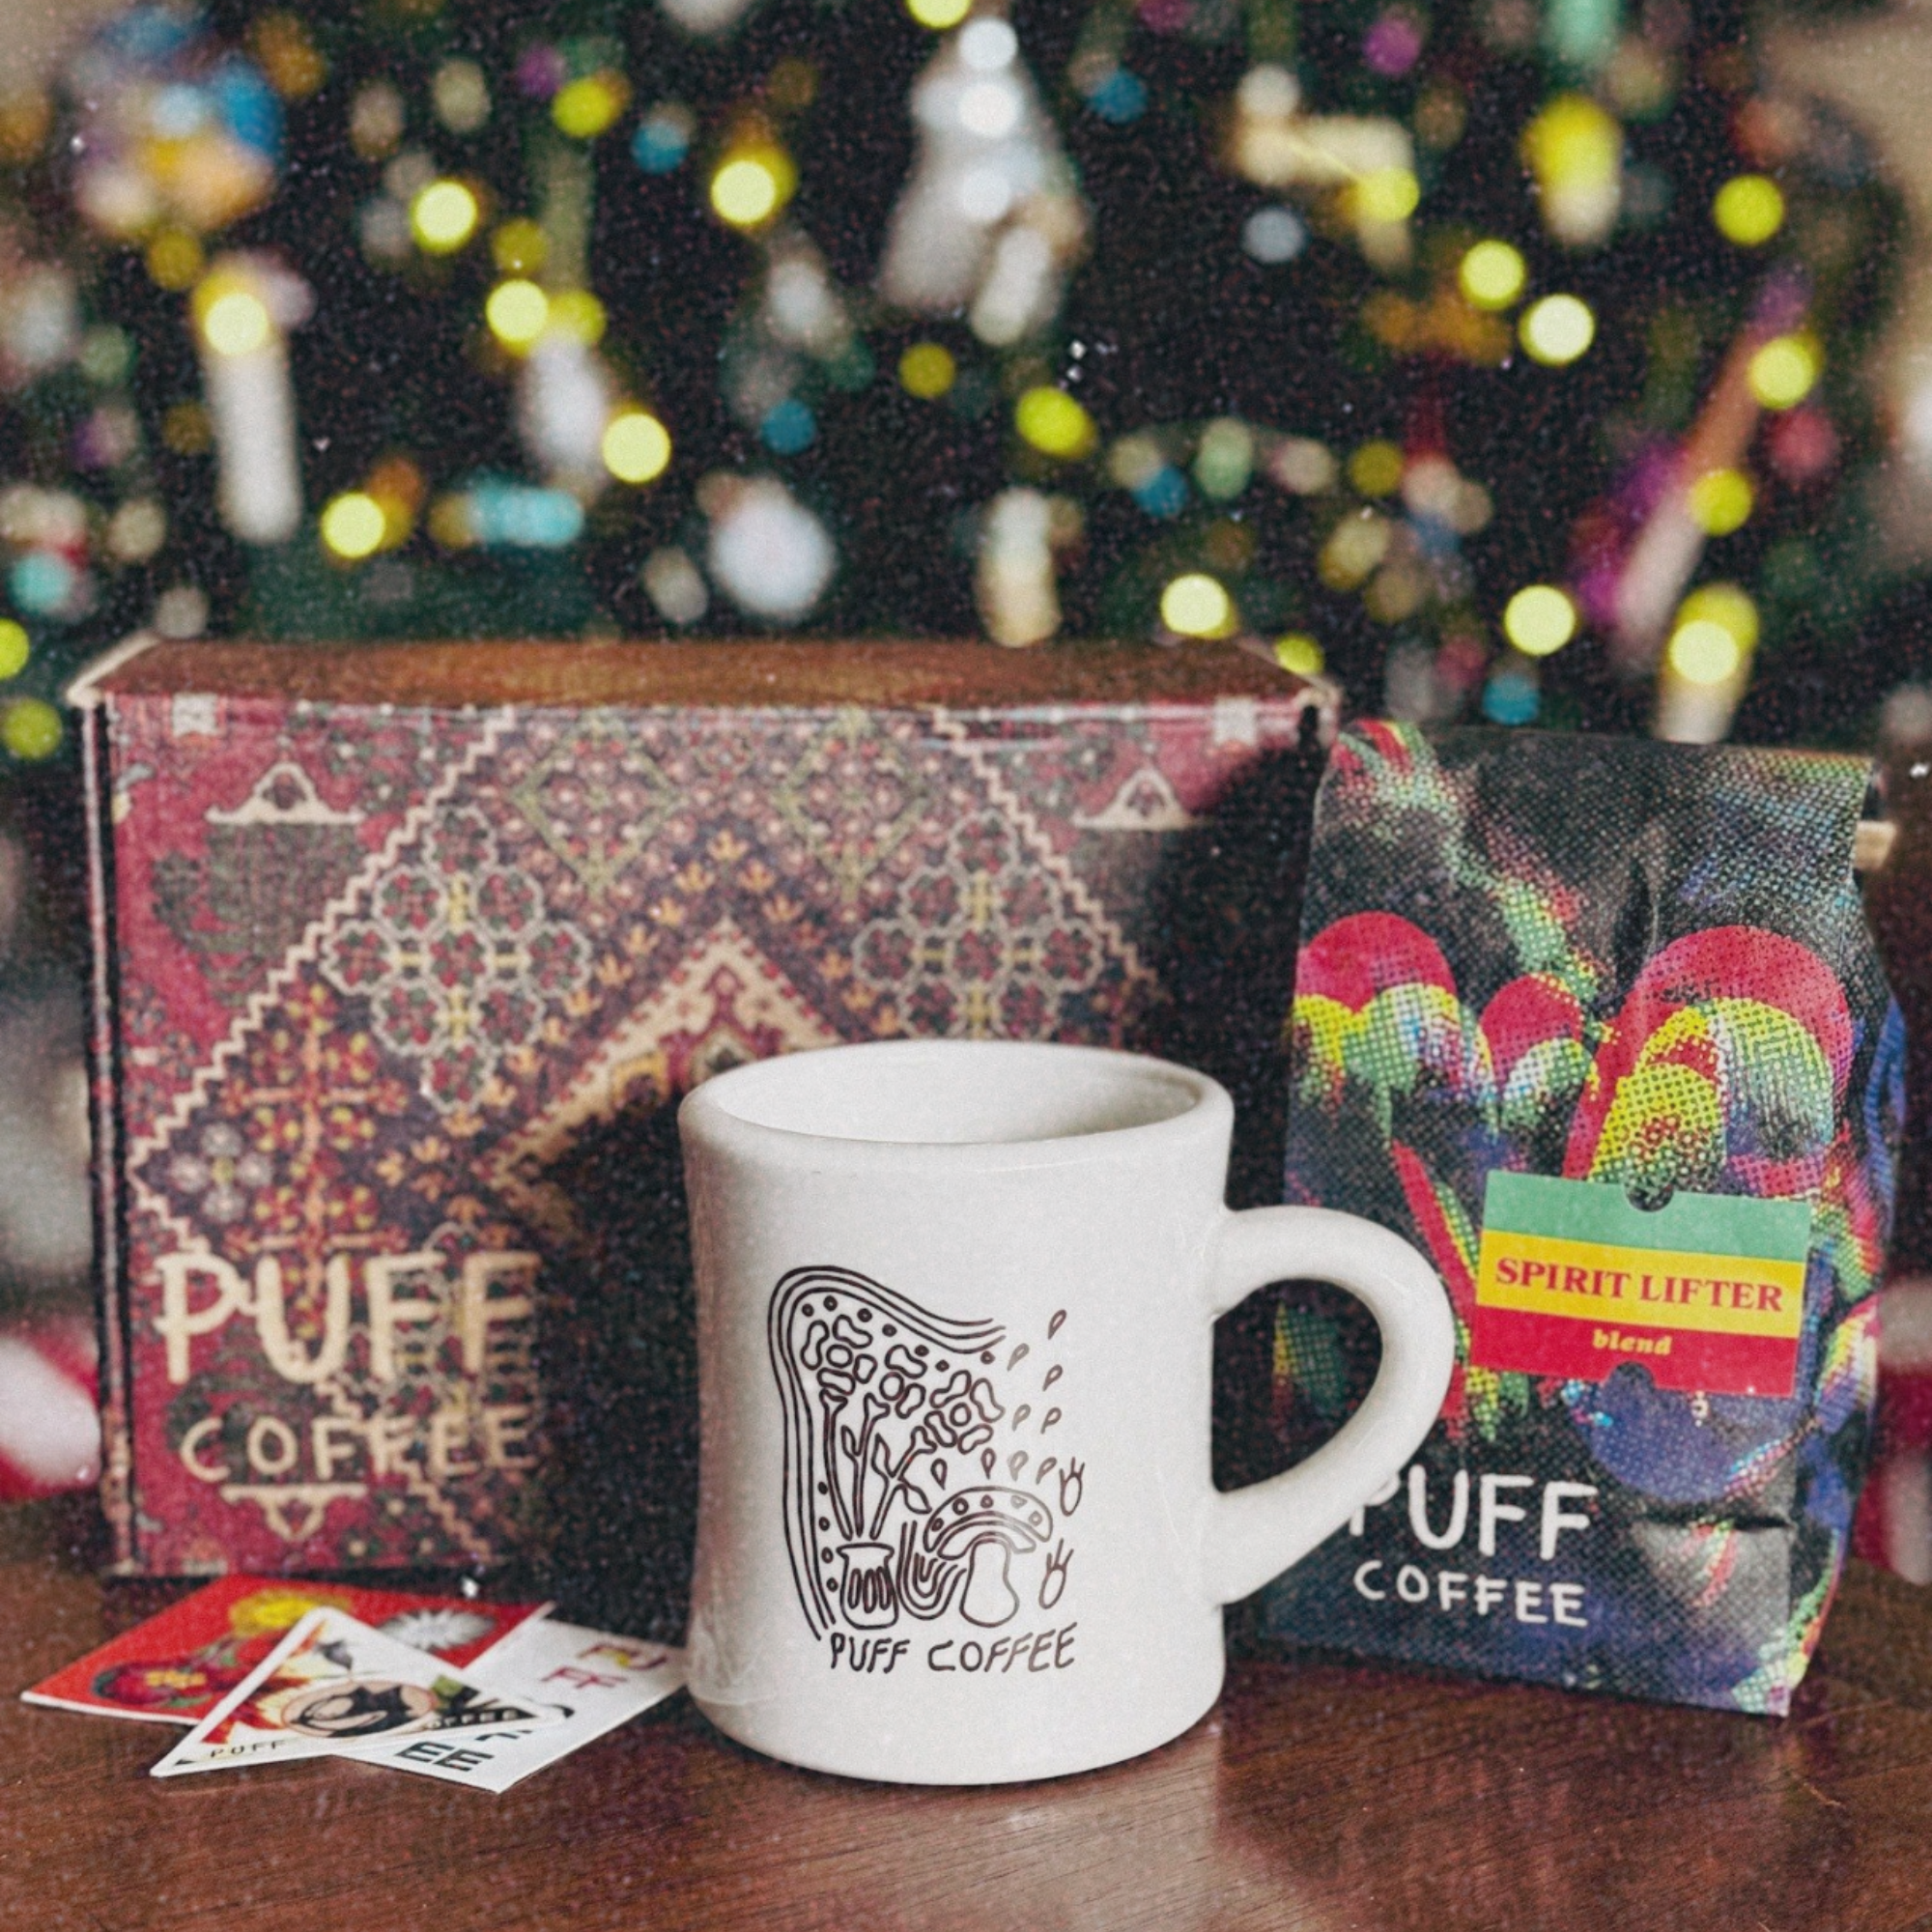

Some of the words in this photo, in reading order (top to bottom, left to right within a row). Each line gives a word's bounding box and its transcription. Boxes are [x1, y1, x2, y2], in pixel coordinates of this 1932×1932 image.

[1495, 1257, 1632, 1299] SPIRIT
[1639, 1274, 1784, 1313] LIFTER
[153, 1251, 543, 1383] PUFF
[1591, 1328, 1673, 1357] blend
[180, 1406, 538, 1483] COFFEE
[1352, 1558, 1589, 1629] COFFEE
[830, 1632, 911, 1674] PUFF
[927, 1621, 1078, 1674] COFFEE
[394, 1740, 496, 1773] EE
